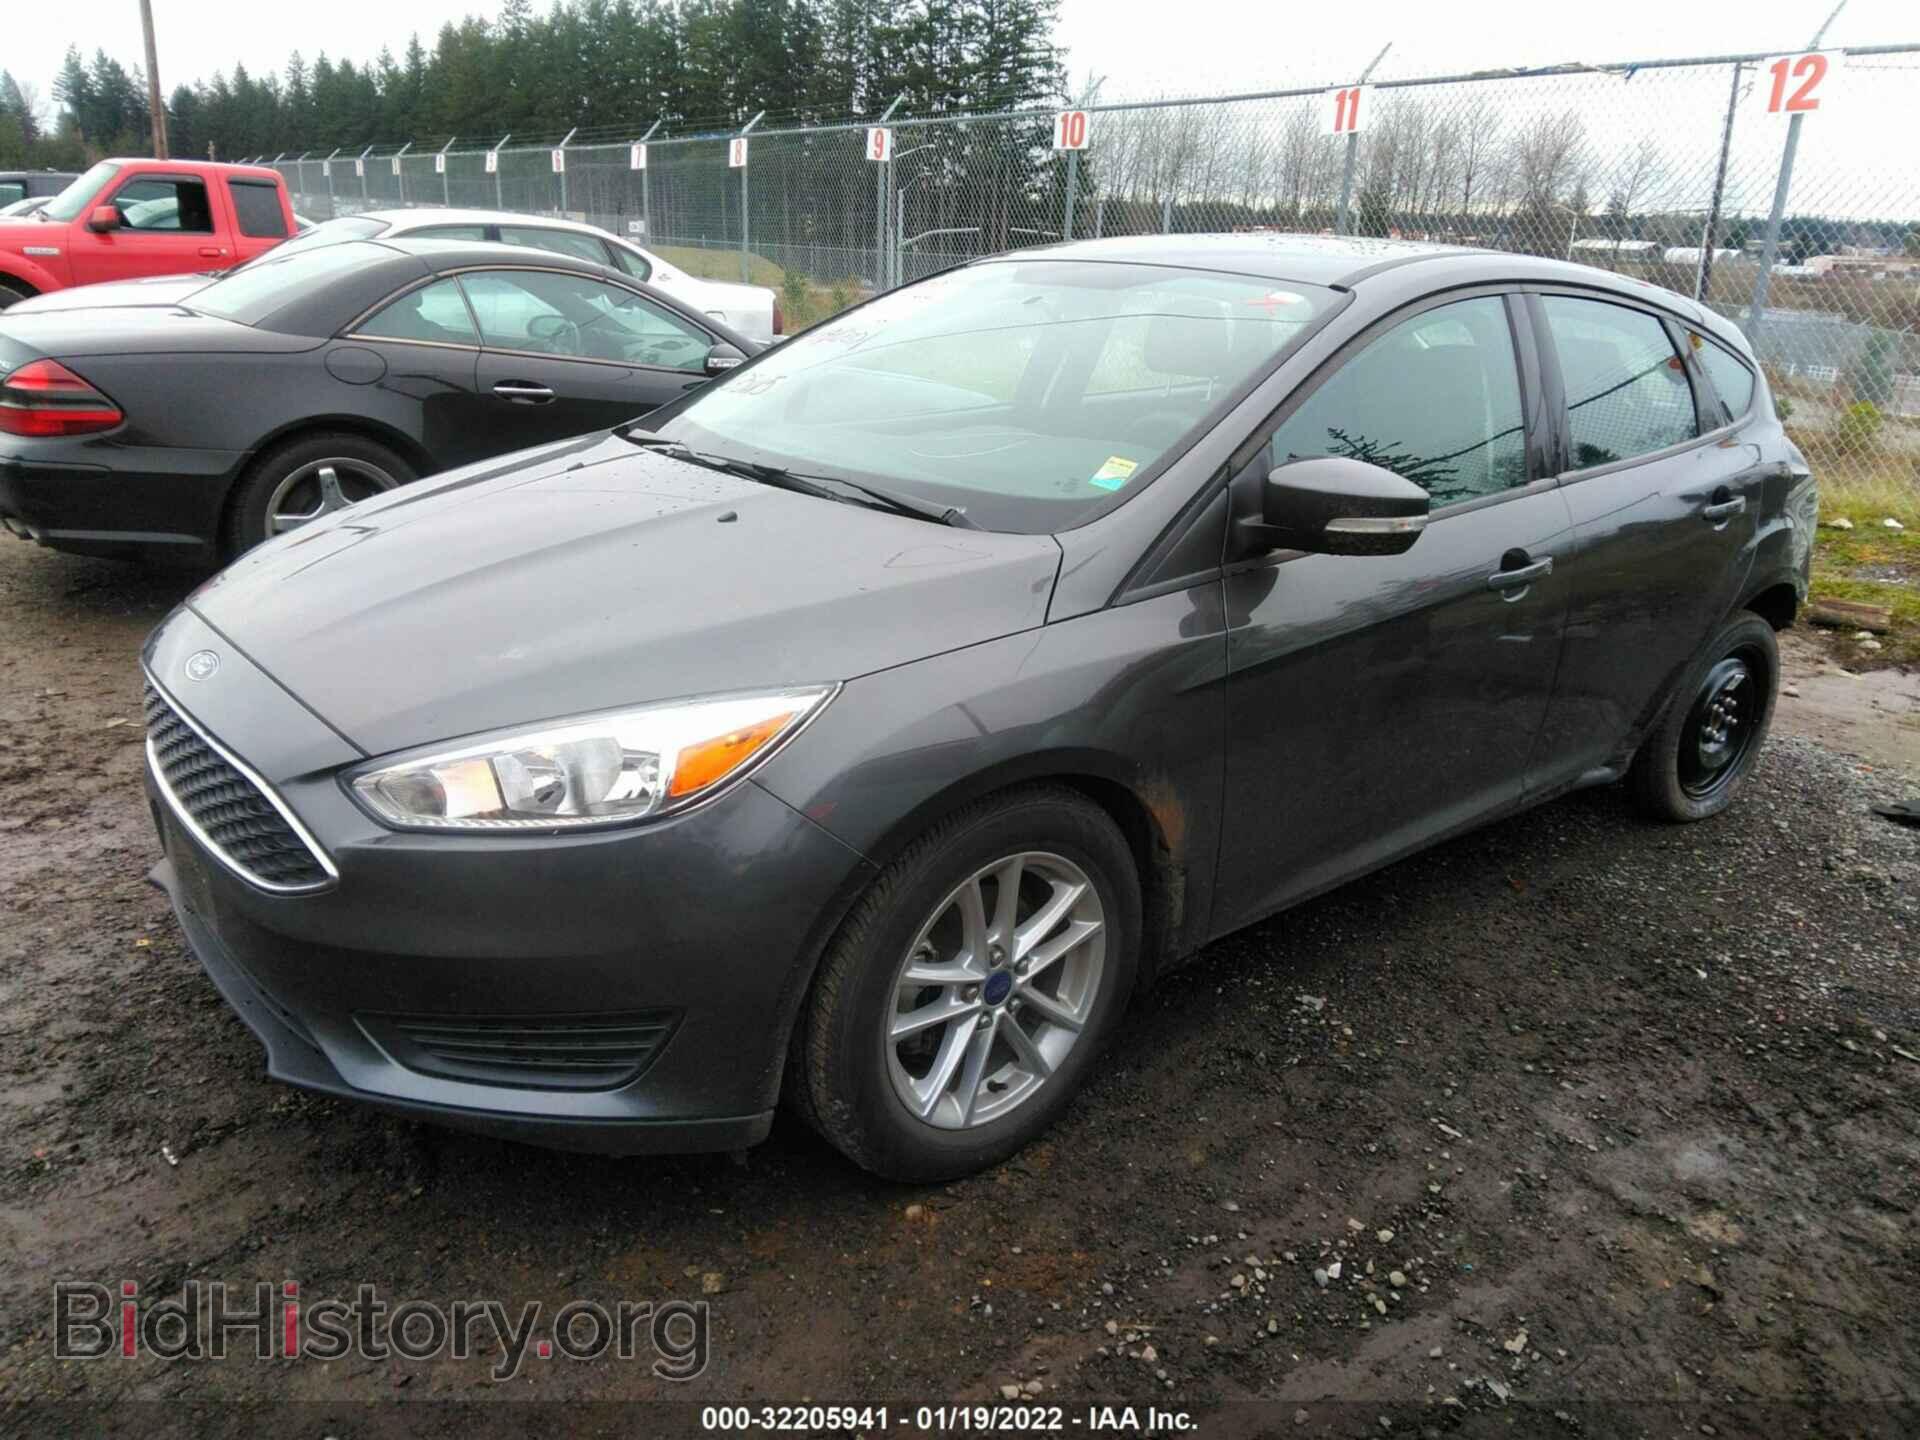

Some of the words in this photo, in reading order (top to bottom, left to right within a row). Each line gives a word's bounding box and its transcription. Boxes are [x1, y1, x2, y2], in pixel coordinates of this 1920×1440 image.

[1766, 54, 1828, 113] 12
[1334, 88, 1361, 131] 11
[873, 129, 884, 160] 9
[1060, 110, 1087, 148] 10
[734, 139, 743, 165] 8
